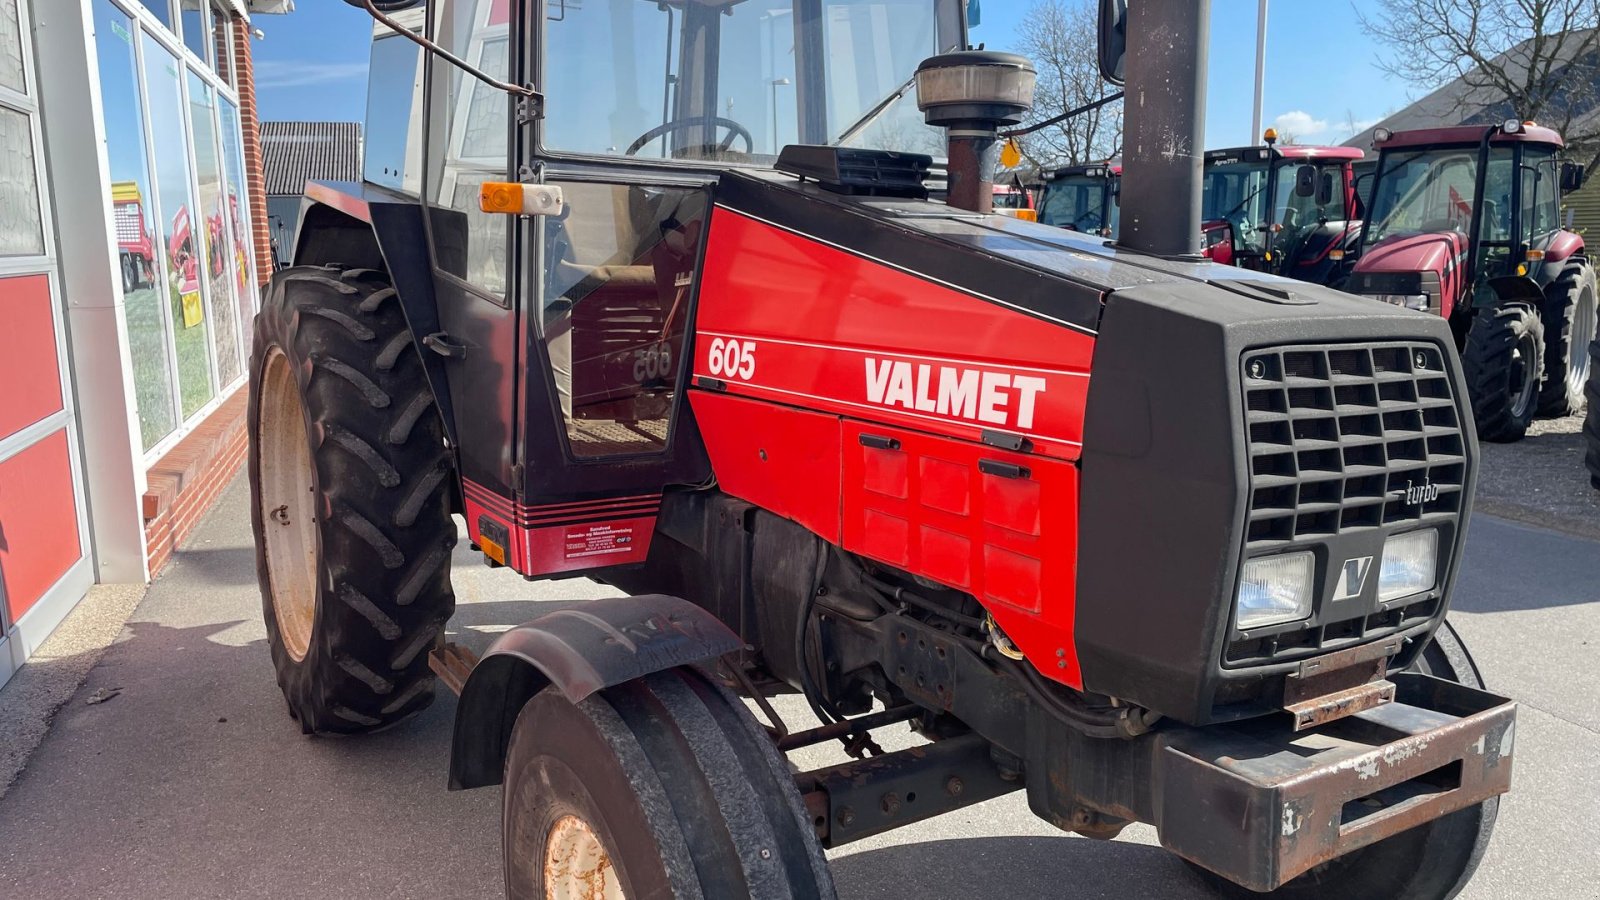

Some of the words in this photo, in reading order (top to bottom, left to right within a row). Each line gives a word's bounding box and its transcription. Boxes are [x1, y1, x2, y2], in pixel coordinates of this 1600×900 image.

[708, 337, 757, 381] 605
[864, 357, 1047, 430] VALMET
[1406, 476, 1439, 506] turbo
